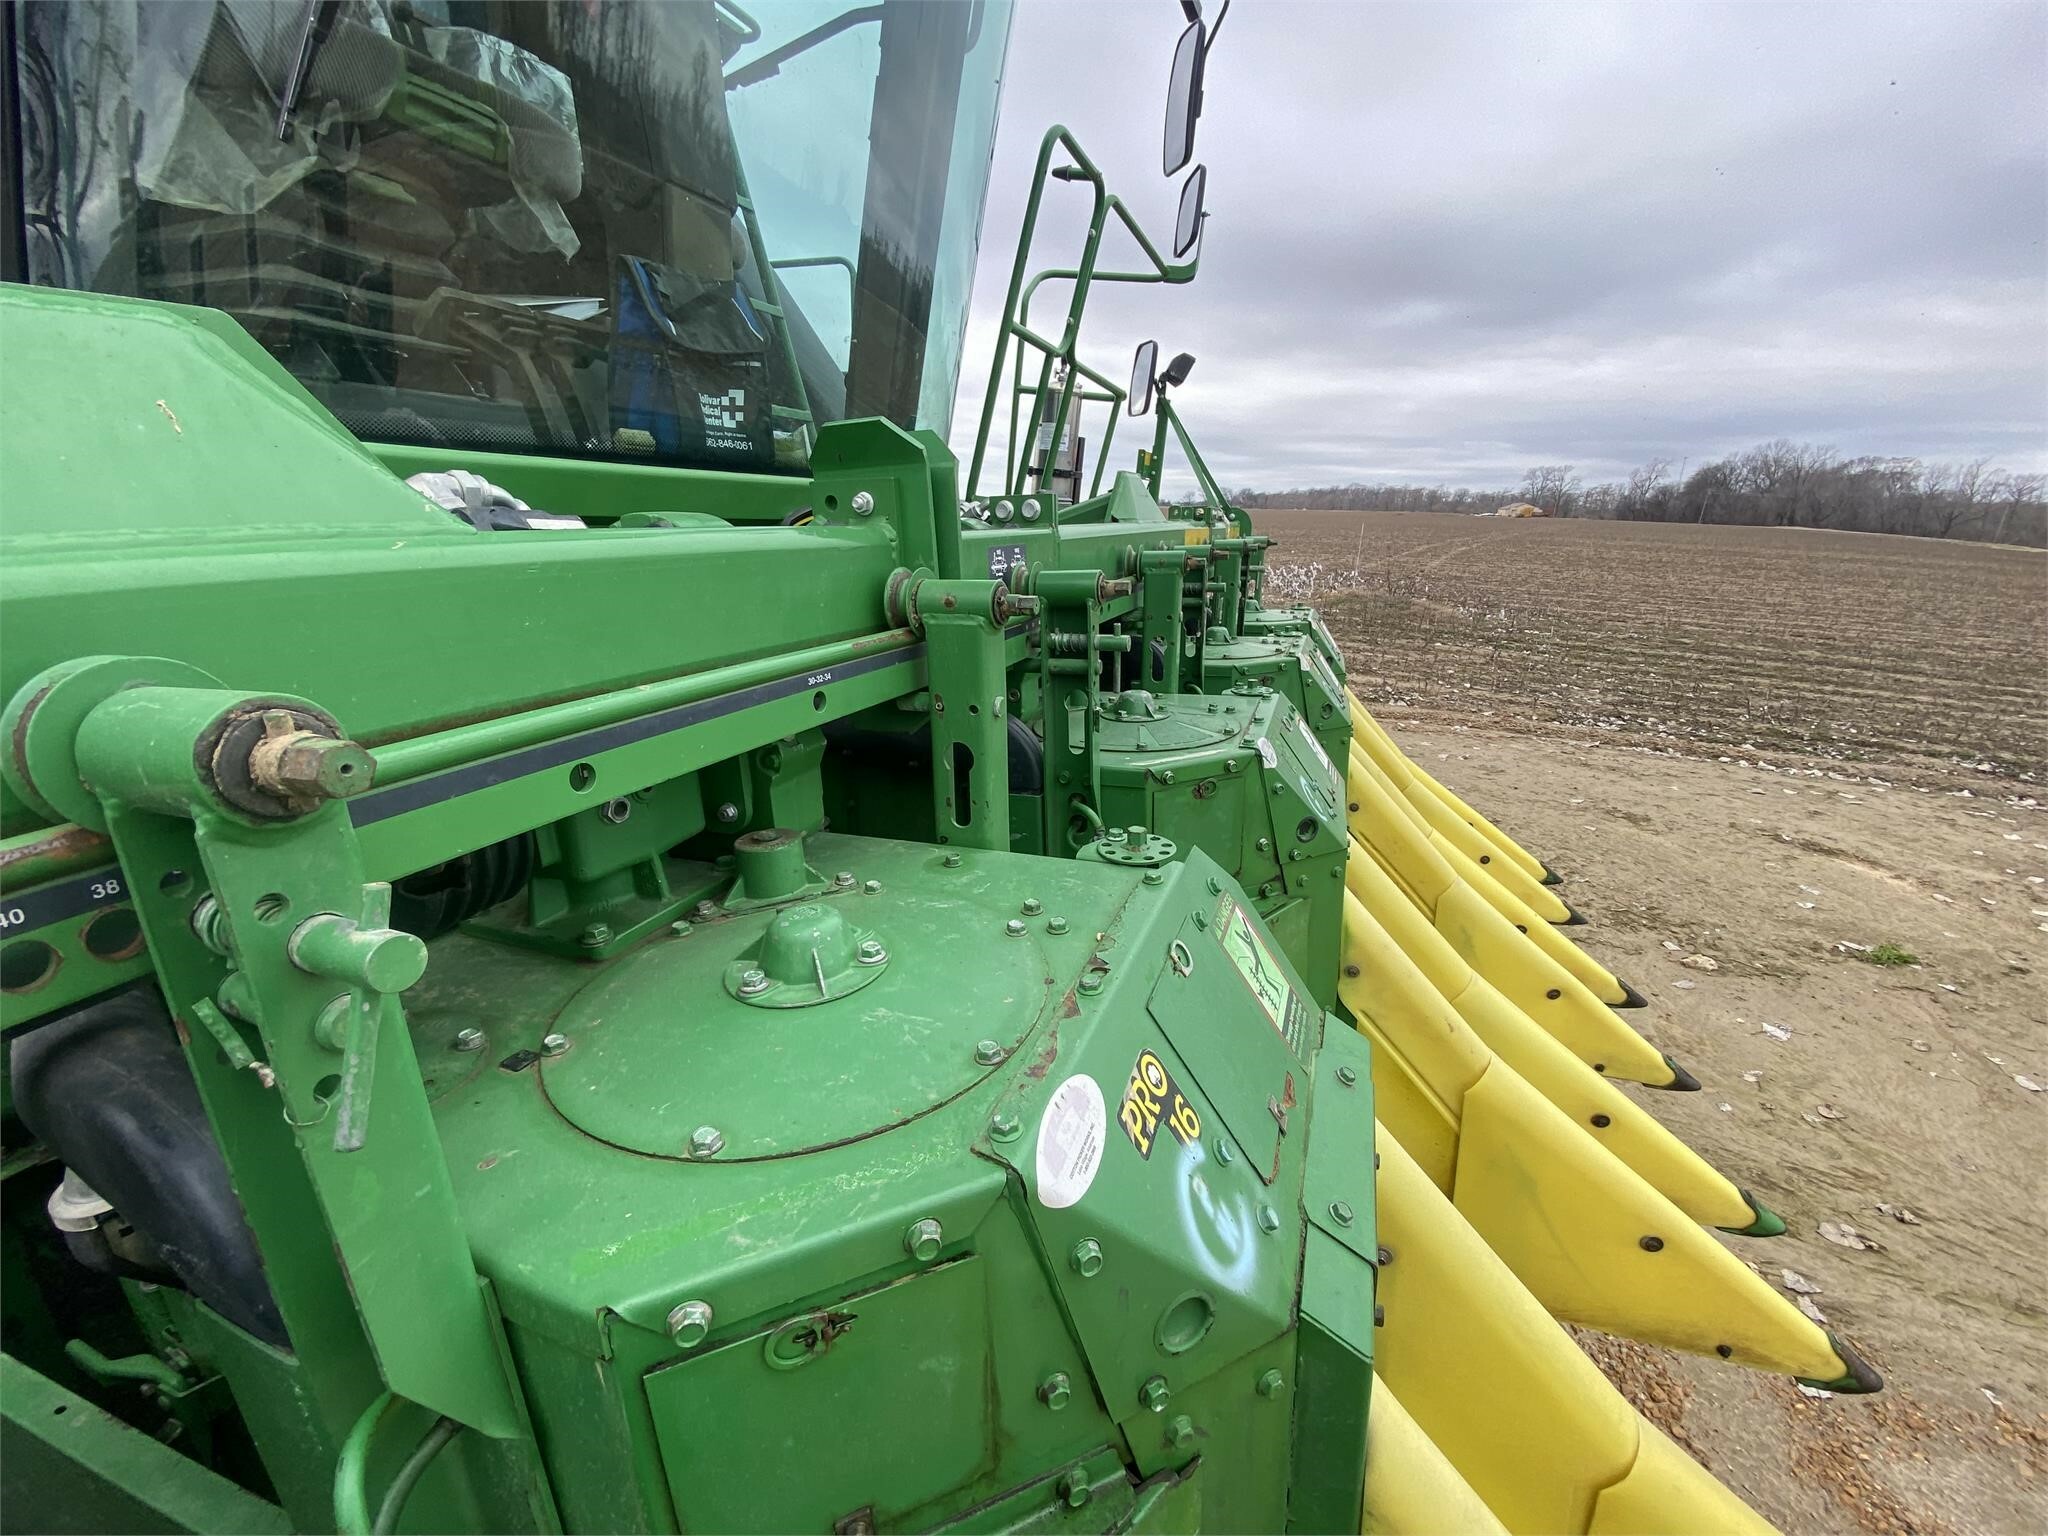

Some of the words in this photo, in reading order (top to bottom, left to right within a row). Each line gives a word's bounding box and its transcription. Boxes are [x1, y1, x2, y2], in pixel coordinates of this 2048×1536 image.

[807, 672, 832, 686] 30-32-34
[90, 879, 120, 899] 38
[0, 908, 25, 928] 40
[1218, 893, 1235, 931] DANGER
[1121, 1053, 1168, 1155] PRO
[1169, 1094, 1201, 1146] 16
